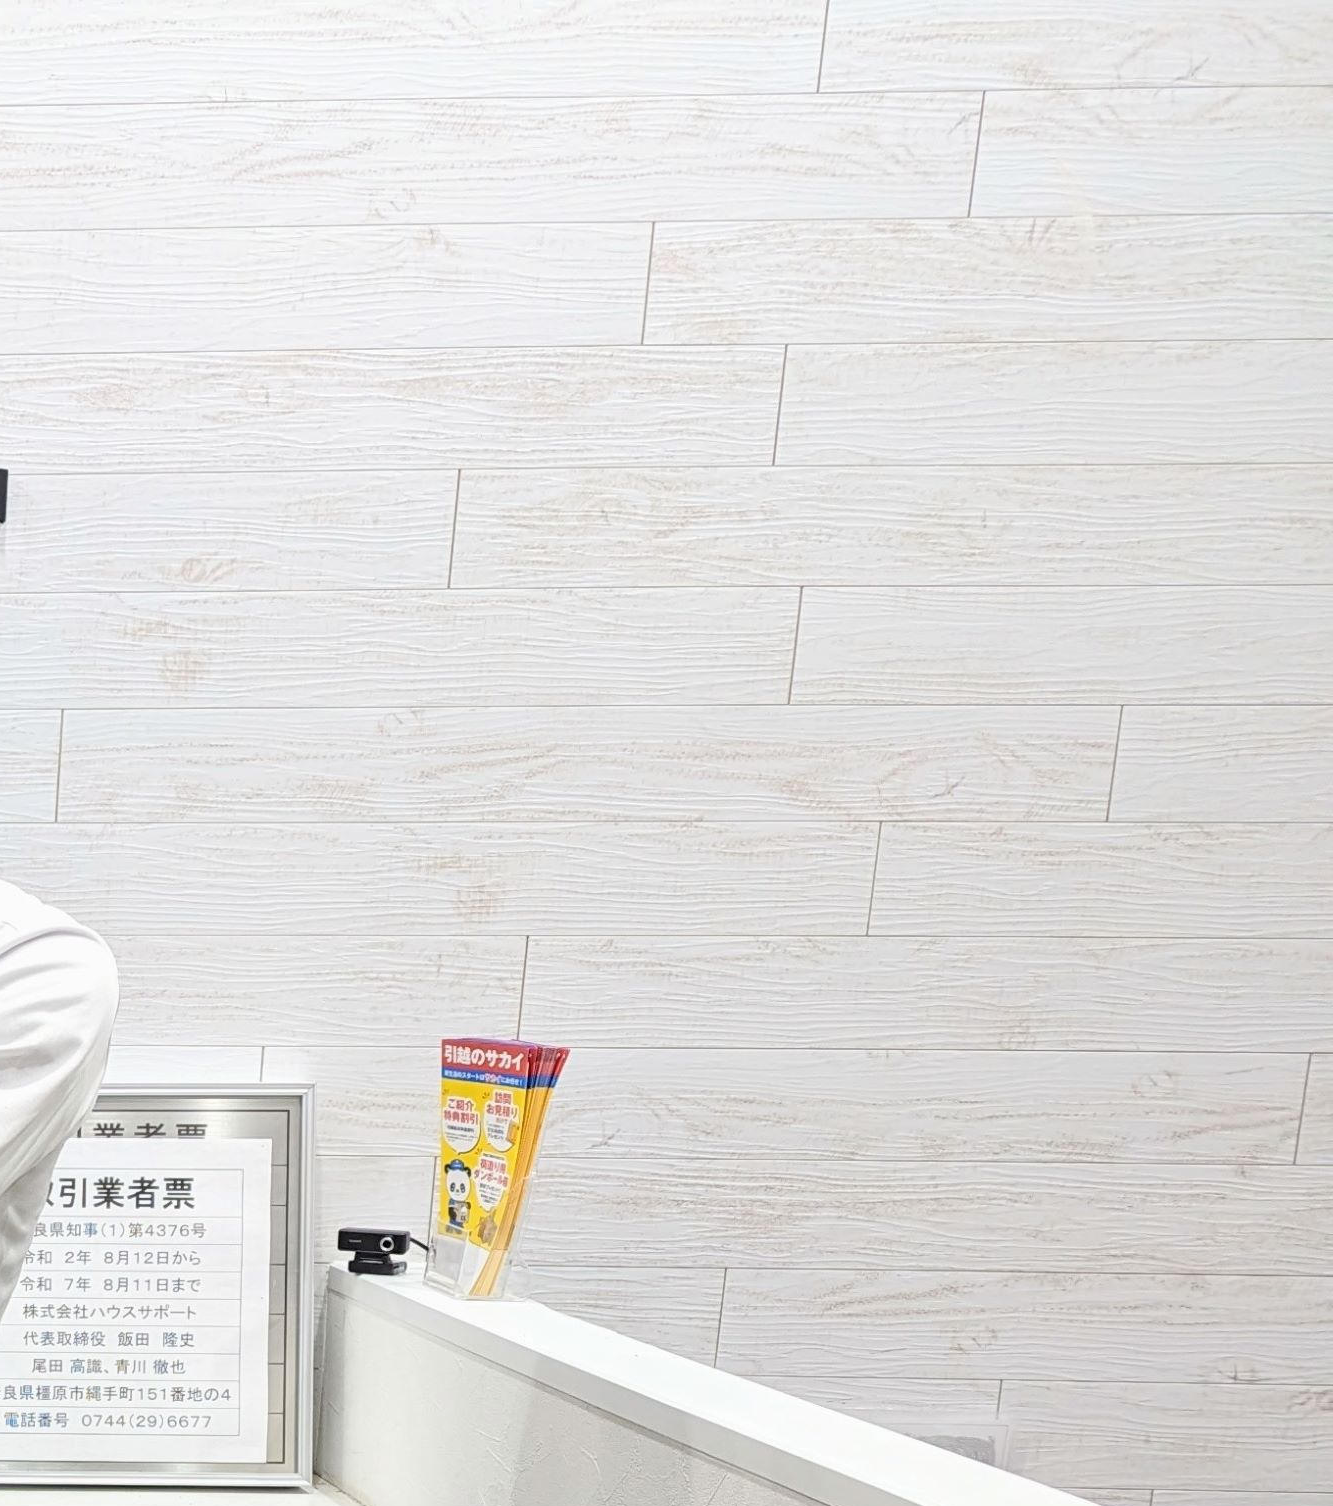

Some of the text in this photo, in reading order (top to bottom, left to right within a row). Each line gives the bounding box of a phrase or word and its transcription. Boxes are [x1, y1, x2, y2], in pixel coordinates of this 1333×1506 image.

[444, 1044, 525, 1071] 引越のサカイ
[45, 1176, 195, 1209] 引業者票
[65, 1251, 92, 1265] 2年
[104, 1252, 202, 1266] 8月12日から
[20, 1277, 201, 1293] 令和 7年 8月11日まで
[23, 1304, 197, 1320] 株式会社ハウスサポート
[23, 1331, 195, 1348] 代表取締役 飯田 隆史
[32, 1359, 63, 1373] 尾田
[153, 1360, 186, 1375] 徹也
[4, 1412, 212, 1429] 電話番号 0744(29)6677
